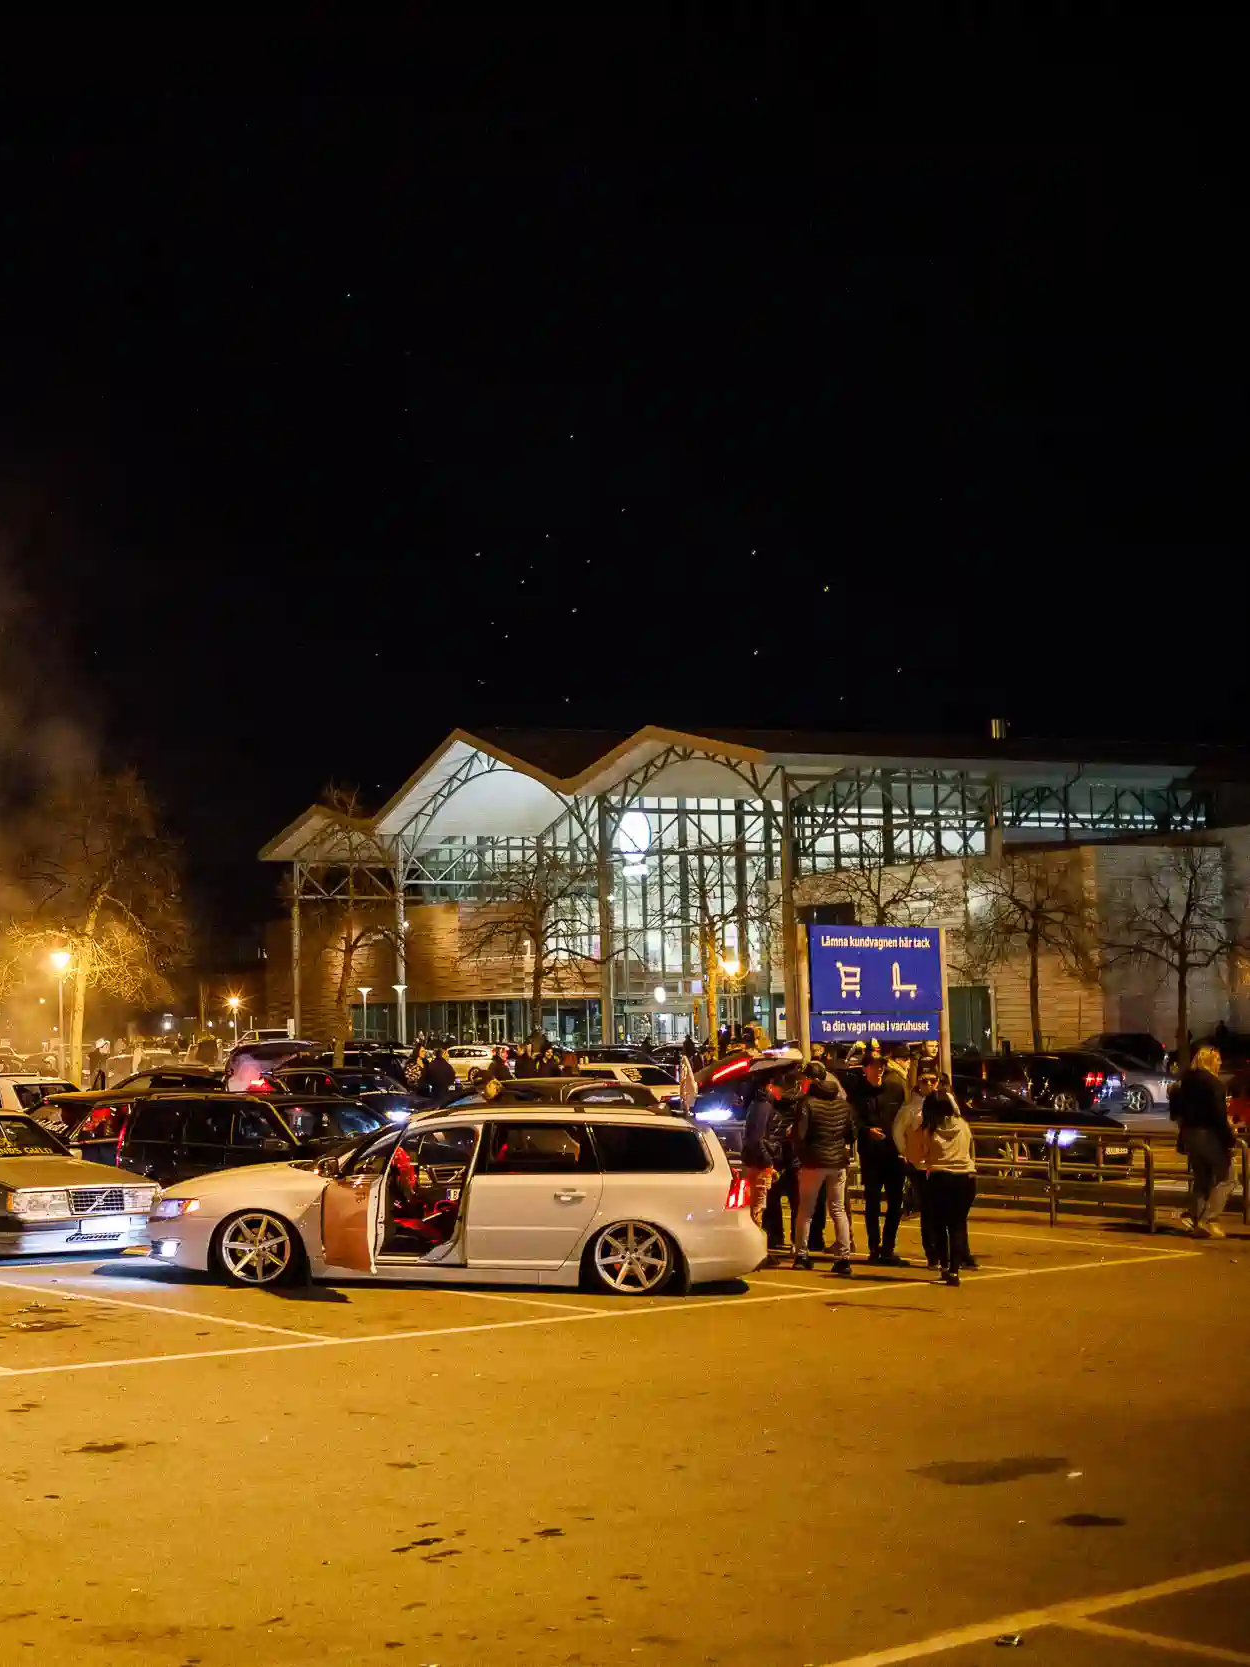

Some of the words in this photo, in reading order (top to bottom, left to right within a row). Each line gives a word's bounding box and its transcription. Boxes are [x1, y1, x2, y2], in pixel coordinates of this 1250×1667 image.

[821, 936, 848, 947] Lämna
[850, 936, 898, 951] kundvagnen
[899, 936, 913, 948] här
[913, 936, 930, 948] tack
[821, 1020, 832, 1032] Ta
[832, 1020, 846, 1032] din
[846, 1022, 867, 1035] vagn
[868, 1020, 886, 1032] inne
[890, 1020, 929, 1032] varuhuset
